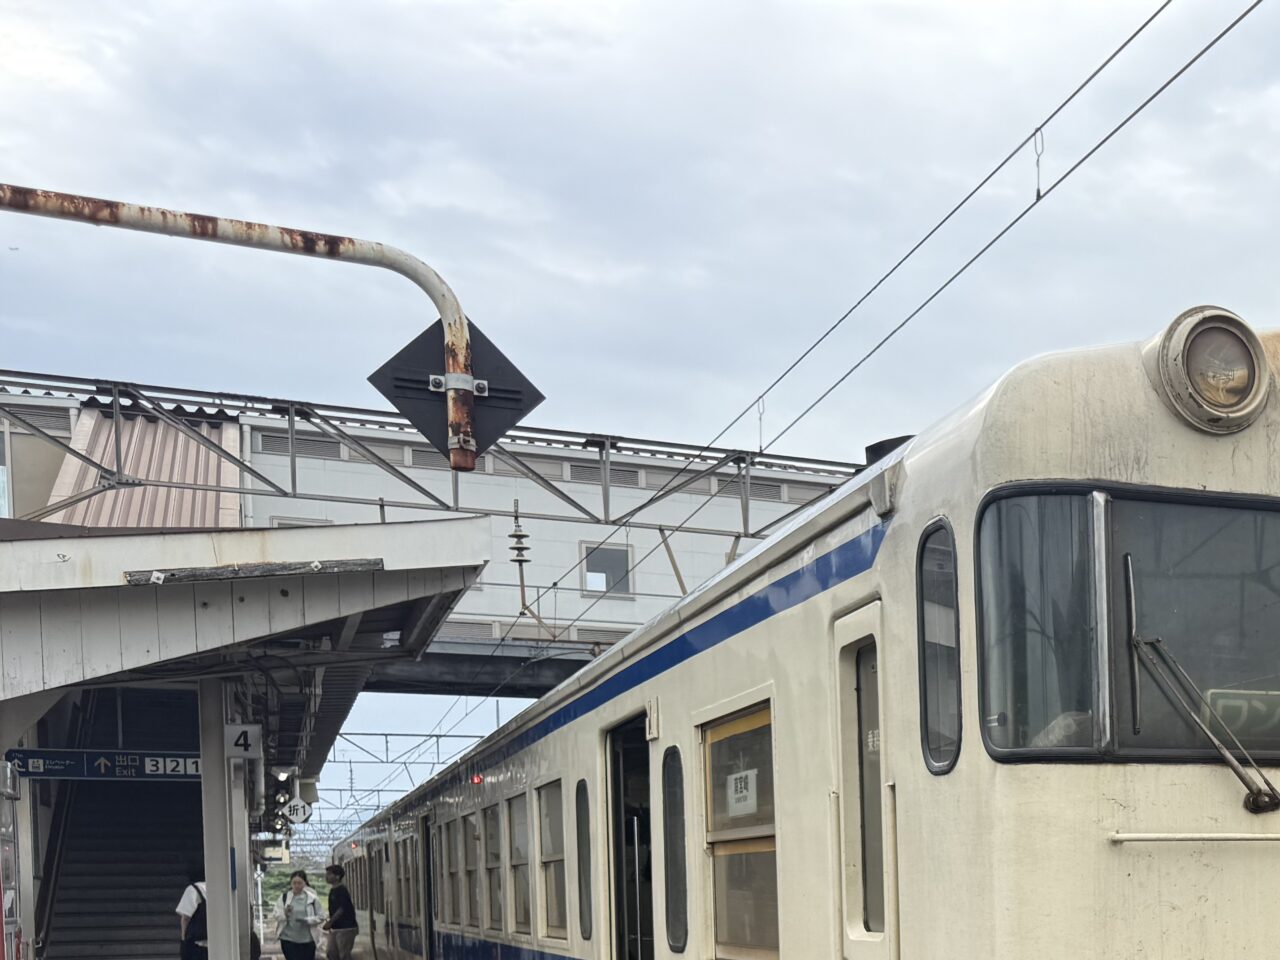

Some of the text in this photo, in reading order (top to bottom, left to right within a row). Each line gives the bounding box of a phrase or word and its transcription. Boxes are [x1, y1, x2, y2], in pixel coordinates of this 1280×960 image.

[234, 730, 251, 751] 4
[115, 755, 140, 766] 出口
[149, 759, 160, 773] 3
[170, 760, 181, 773] 2
[115, 767, 137, 777] Exit
[288, 804, 306, 817] 折1
